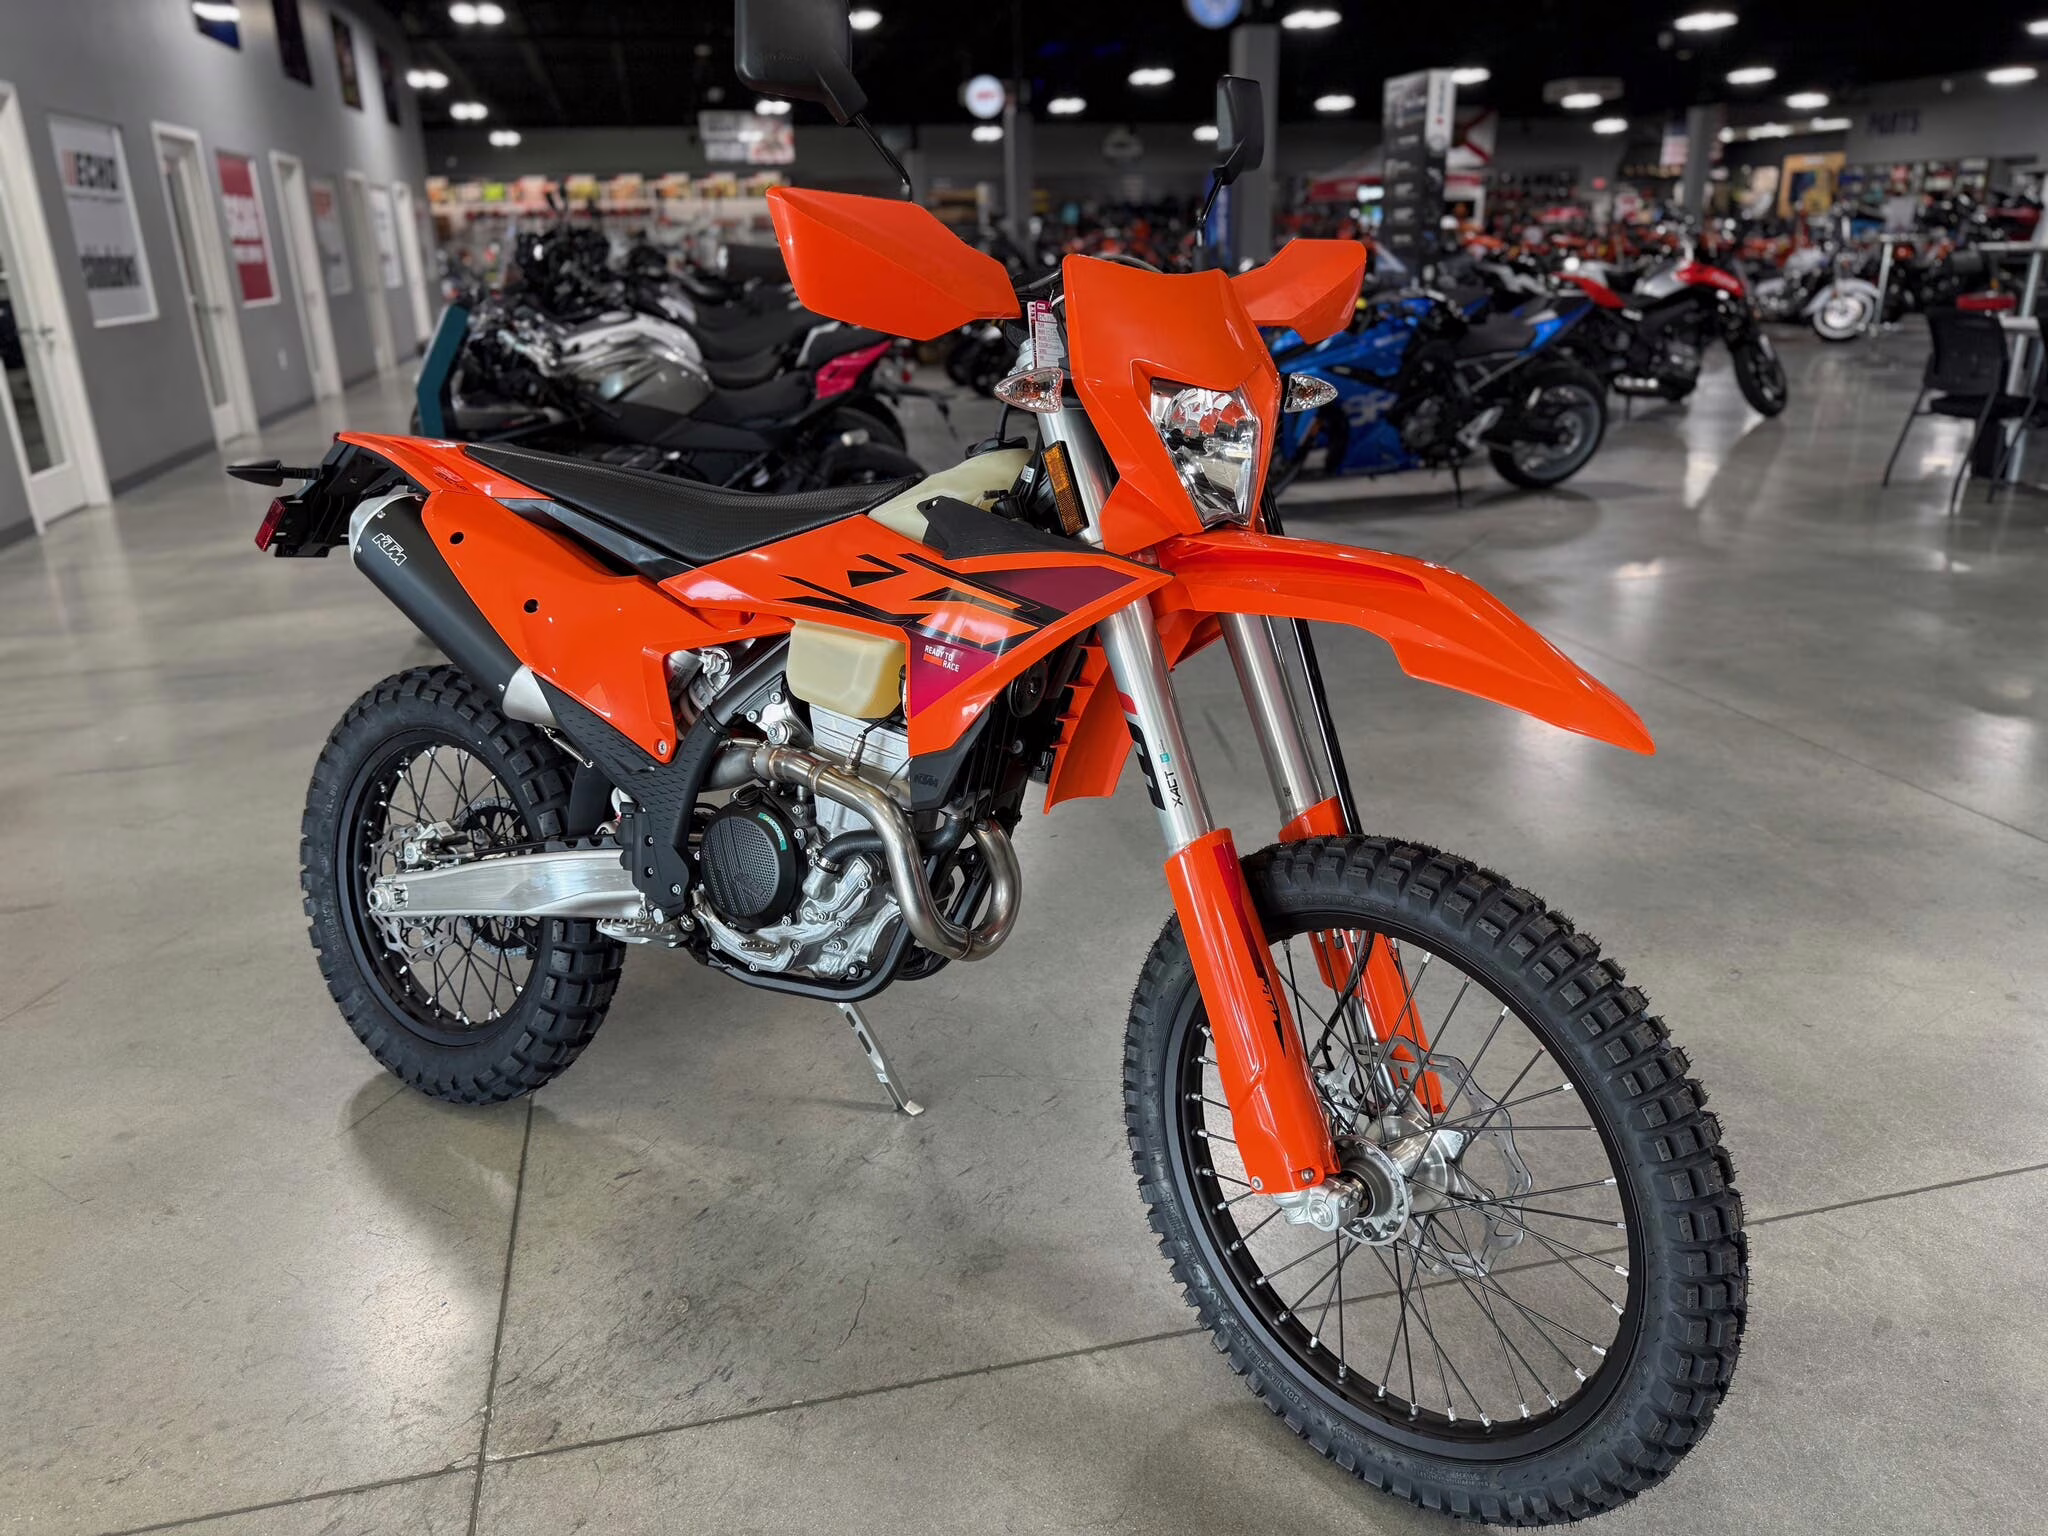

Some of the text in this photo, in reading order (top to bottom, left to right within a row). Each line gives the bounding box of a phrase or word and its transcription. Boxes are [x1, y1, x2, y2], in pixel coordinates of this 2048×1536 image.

[372, 533, 407, 566] KTM
[924, 645, 954, 662] READY TO
[942, 659, 960, 672] RACE
[1164, 771, 1184, 808] XACT
